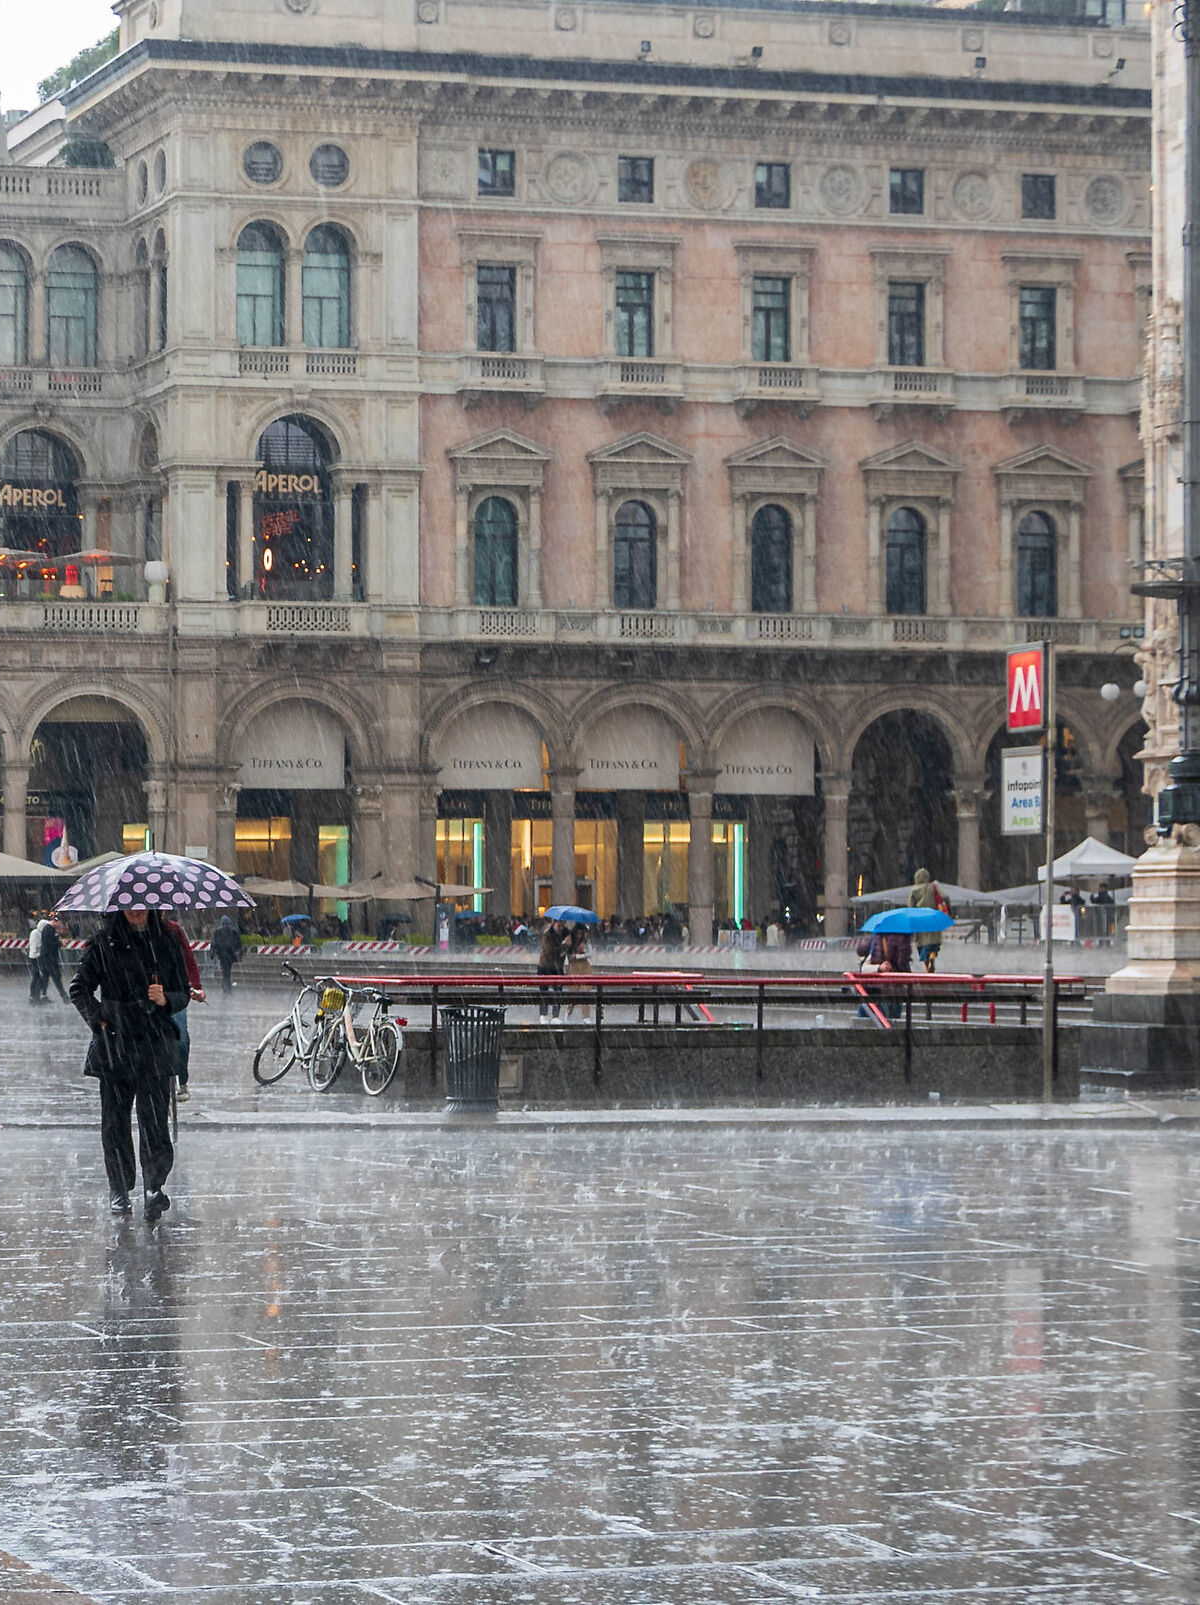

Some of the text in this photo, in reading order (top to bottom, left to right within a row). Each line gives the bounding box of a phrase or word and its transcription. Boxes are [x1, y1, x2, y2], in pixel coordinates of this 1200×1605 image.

[253, 470, 322, 493] APEROL
[1010, 664, 1041, 713] M
[1012, 797, 1033, 808] Area
[1012, 815, 1034, 826] Area
